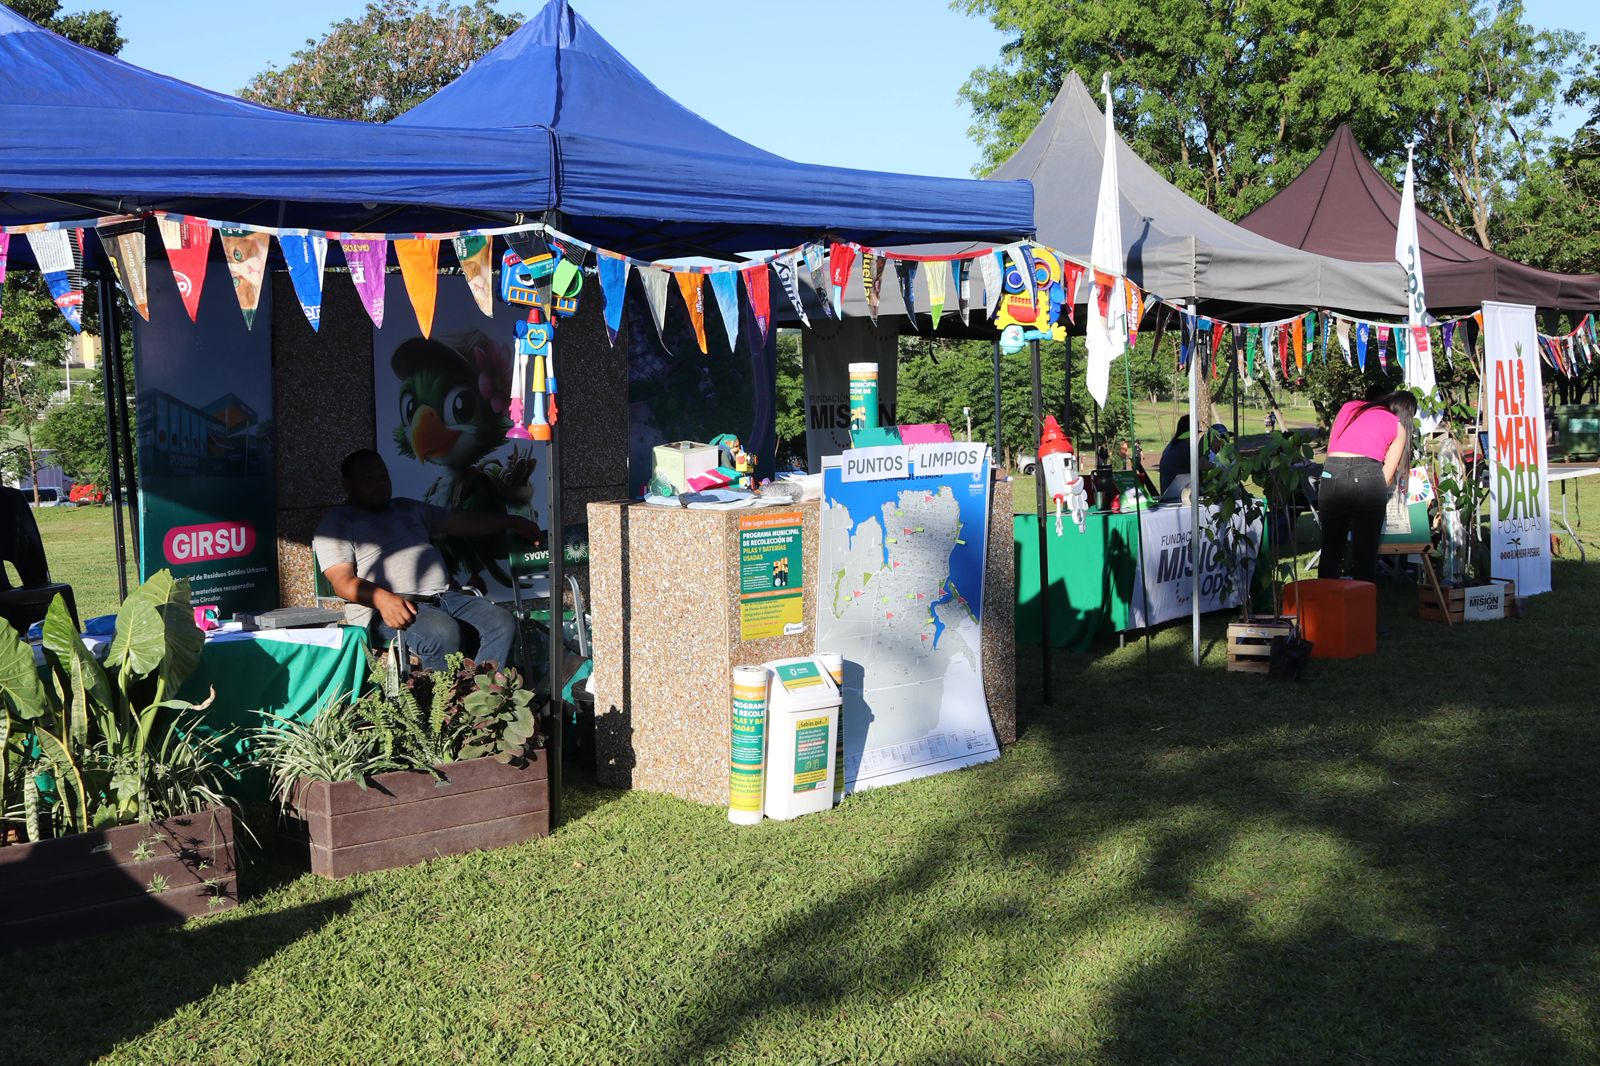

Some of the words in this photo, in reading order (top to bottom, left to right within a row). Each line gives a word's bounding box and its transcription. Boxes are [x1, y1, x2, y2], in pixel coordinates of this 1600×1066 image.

[343, 243, 370, 253] GATOS
[862, 253, 873, 305] uellas
[811, 403, 896, 429] MISN
[1495, 417, 1538, 471] MEN
[847, 455, 903, 476] PUNTOS
[920, 450, 978, 469] LIMPIOS
[1498, 463, 1541, 521] DAR
[1498, 516, 1542, 535] POSADAS
[743, 530, 771, 540] PROGRAMA
[772, 528, 800, 537] MUNICIPAL
[750, 536, 786, 546] RECOLECCIÓN
[1161, 531, 1193, 546] FUNDAC
[172, 527, 246, 560] GIRSU
[524, 551, 550, 561] SADAS
[743, 553, 764, 561] USADAS
[203, 571, 227, 580] Residuos
[1469, 595, 1499, 607] MISIÓN
